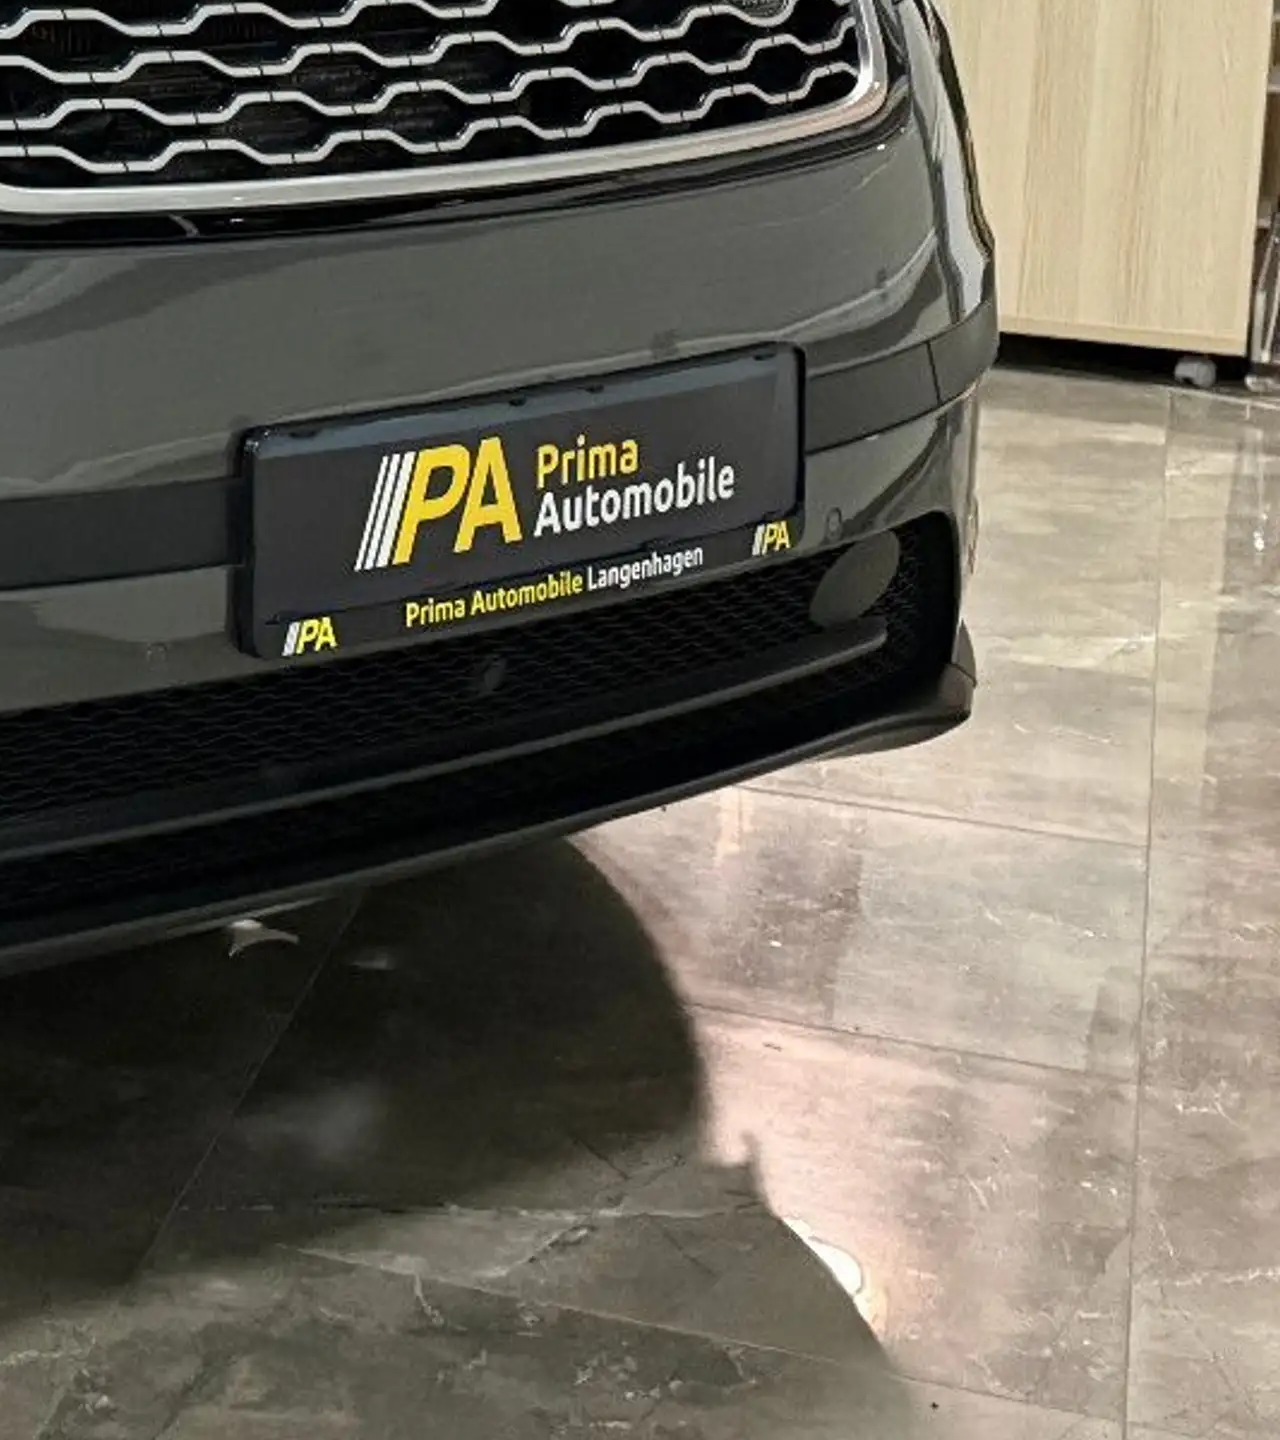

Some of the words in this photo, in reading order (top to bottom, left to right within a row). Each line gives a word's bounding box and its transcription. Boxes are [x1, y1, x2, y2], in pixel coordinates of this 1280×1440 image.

[391, 435, 523, 566] PA
[534, 461, 737, 538] Automobile
[536, 436, 639, 490] Prima
[405, 598, 466, 628] Prima
[470, 575, 584, 617] Automobile
[586, 545, 704, 591] Langenhagen
